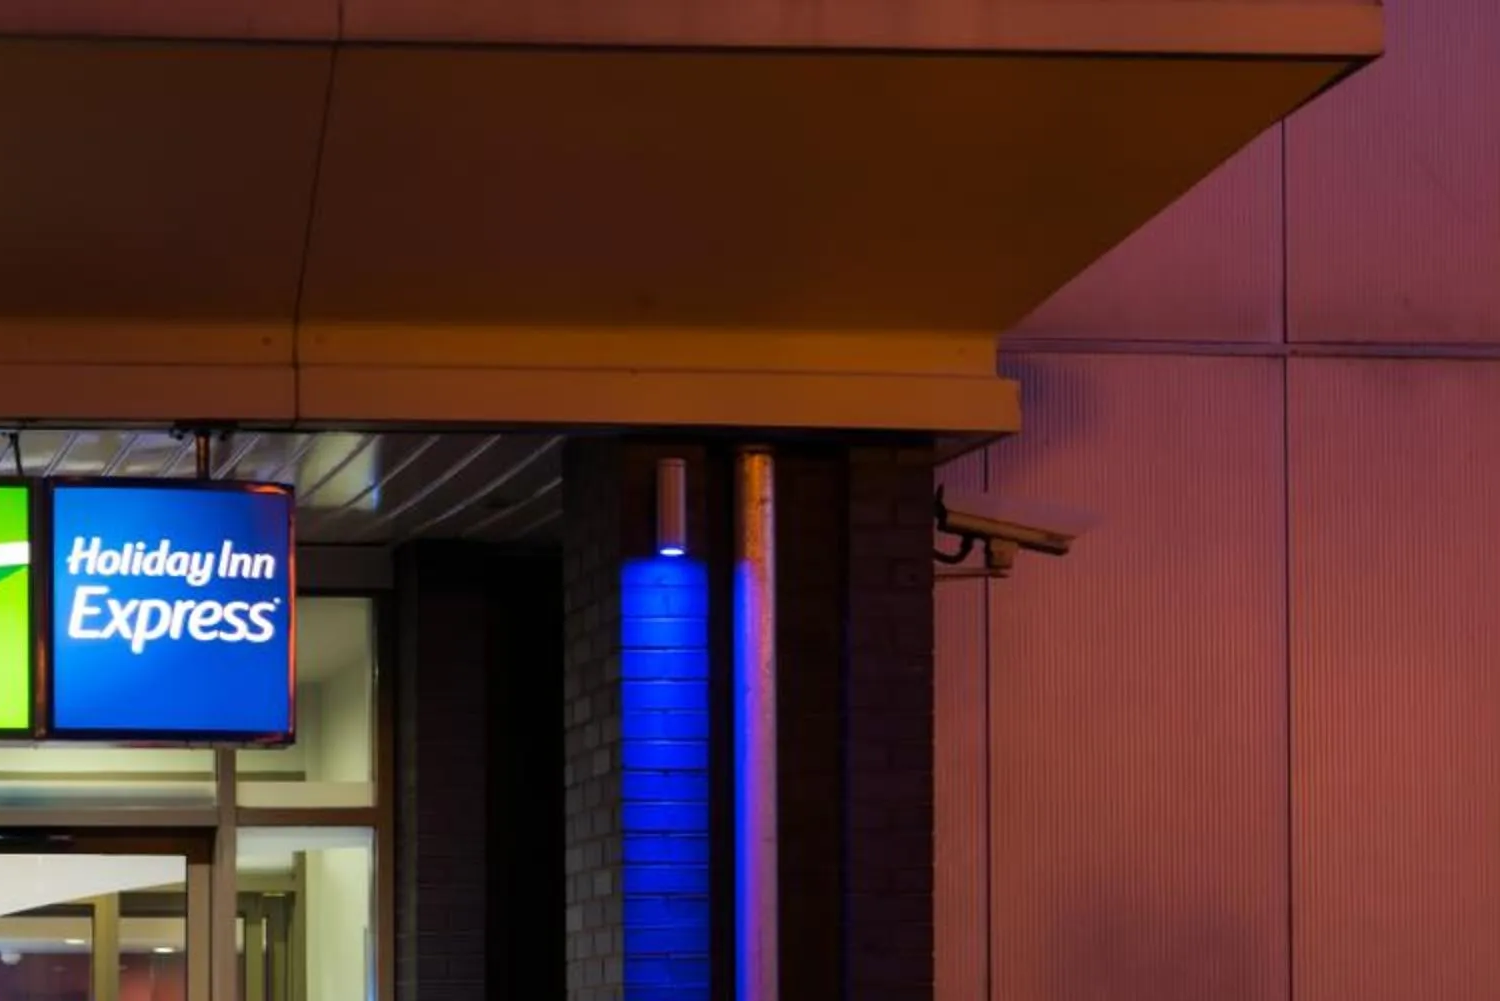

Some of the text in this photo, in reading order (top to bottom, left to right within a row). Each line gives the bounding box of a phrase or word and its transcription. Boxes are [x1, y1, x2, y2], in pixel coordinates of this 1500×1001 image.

[66, 536, 276, 587] Holiday Inn
[67, 585, 277, 655] Express
